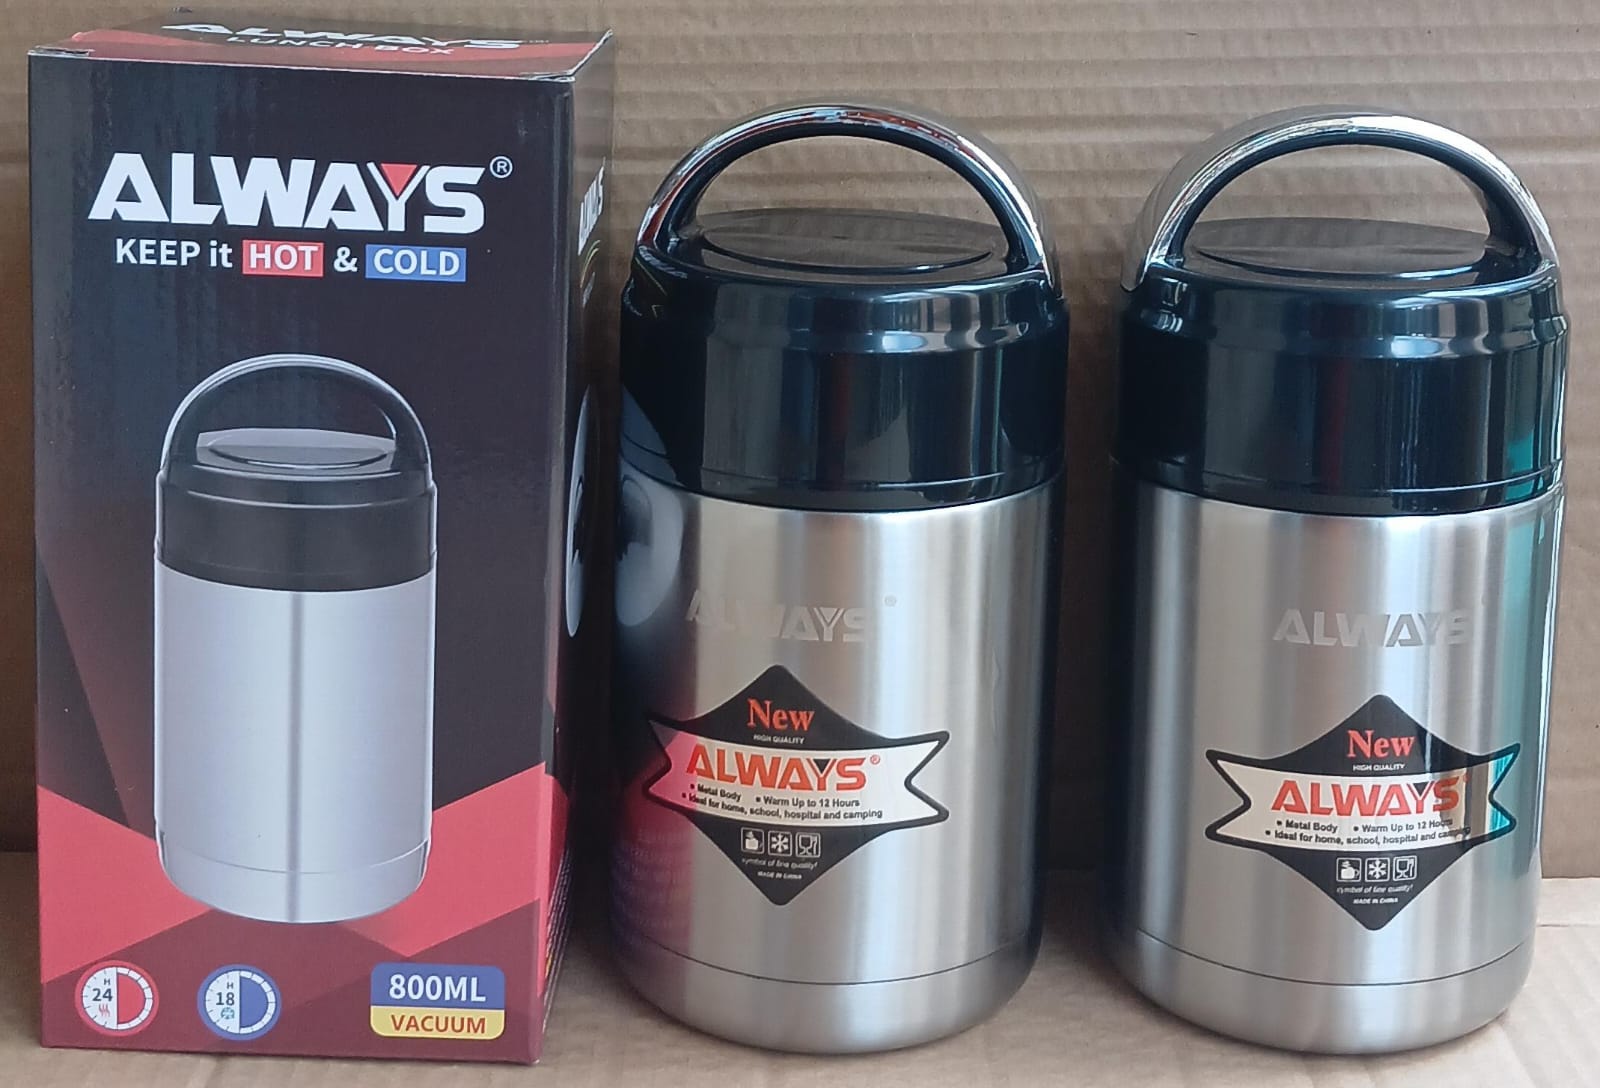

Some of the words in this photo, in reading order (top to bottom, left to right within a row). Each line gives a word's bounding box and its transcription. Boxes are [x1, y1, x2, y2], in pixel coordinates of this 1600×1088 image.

[162, 23, 522, 49] ALWAYS
[226, 35, 361, 50] LUNCH
[376, 43, 455, 55] BOX
[87, 152, 485, 234] ALWAYS
[116, 238, 200, 266] KEEP
[209, 239, 233, 268] it
[249, 243, 318, 271] HOT
[333, 246, 358, 273] &
[373, 248, 460, 277] COLD
[746, 699, 816, 732] New
[753, 733, 772, 743] HIGH
[772, 735, 805, 745] QUALITY
[1346, 729, 1415, 759] New
[686, 743, 867, 792] ALWAYS
[1352, 763, 1372, 772] HIGH
[1373, 763, 1406, 772] QUALITY
[697, 783, 718, 797] Metal
[719, 788, 742, 803] Body
[763, 795, 789, 806] Warm
[791, 798, 805, 808] Up
[807, 799, 817, 807] to
[819, 799, 830, 808] 12
[832, 798, 860, 808] Hours
[1271, 776, 1460, 817] ALWAYS
[708, 798, 720, 809] for
[721, 800, 748, 816] home,
[749, 806, 782, 819] school,
[784, 809, 822, 821] hospital
[823, 810, 841, 820] and
[842, 808, 883, 821] camping
[1285, 819, 1311, 831] Metal
[1313, 822, 1338, 834] Body
[1361, 823, 1389, 833] Warm
[1390, 823, 1404, 834] Up
[1405, 823, 1415, 831] to
[1417, 821, 1427, 830] 12
[1274, 829, 1297, 841] Ideal
[1299, 832, 1313, 843] for
[1314, 835, 1344, 846] home,
[1346, 836, 1381, 846] school,
[1382, 834, 1419, 845] hospital
[1420, 832, 1436, 841] and
[1363, 885, 1373, 894] of
[92, 988, 113, 1002] 24
[226, 982, 234, 990] H
[388, 974, 487, 1003] 800ML
[215, 992, 235, 1007] 18
[390, 1014, 487, 1035] VACUUM
